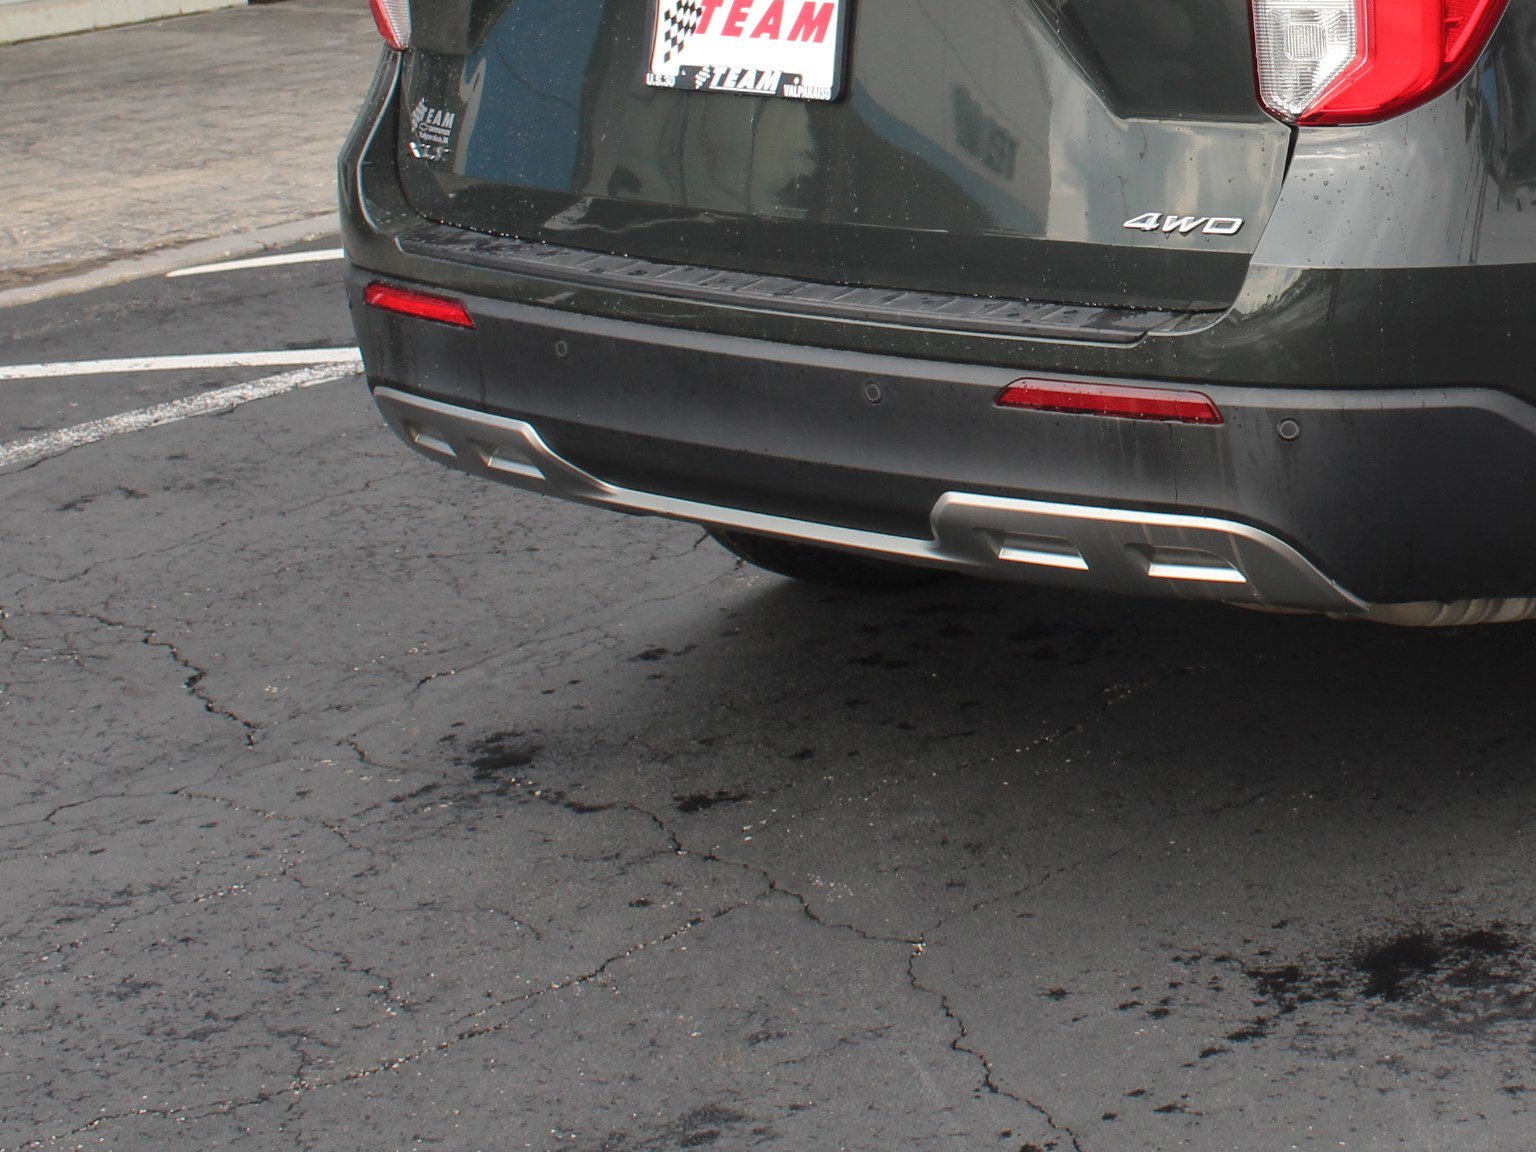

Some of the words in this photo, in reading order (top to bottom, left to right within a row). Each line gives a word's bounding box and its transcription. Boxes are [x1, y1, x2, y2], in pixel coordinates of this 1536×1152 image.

[709, 65, 783, 91] TEAM
[783, 83, 832, 101] VALPARAISO
[1122, 211, 1246, 237] 4WD
